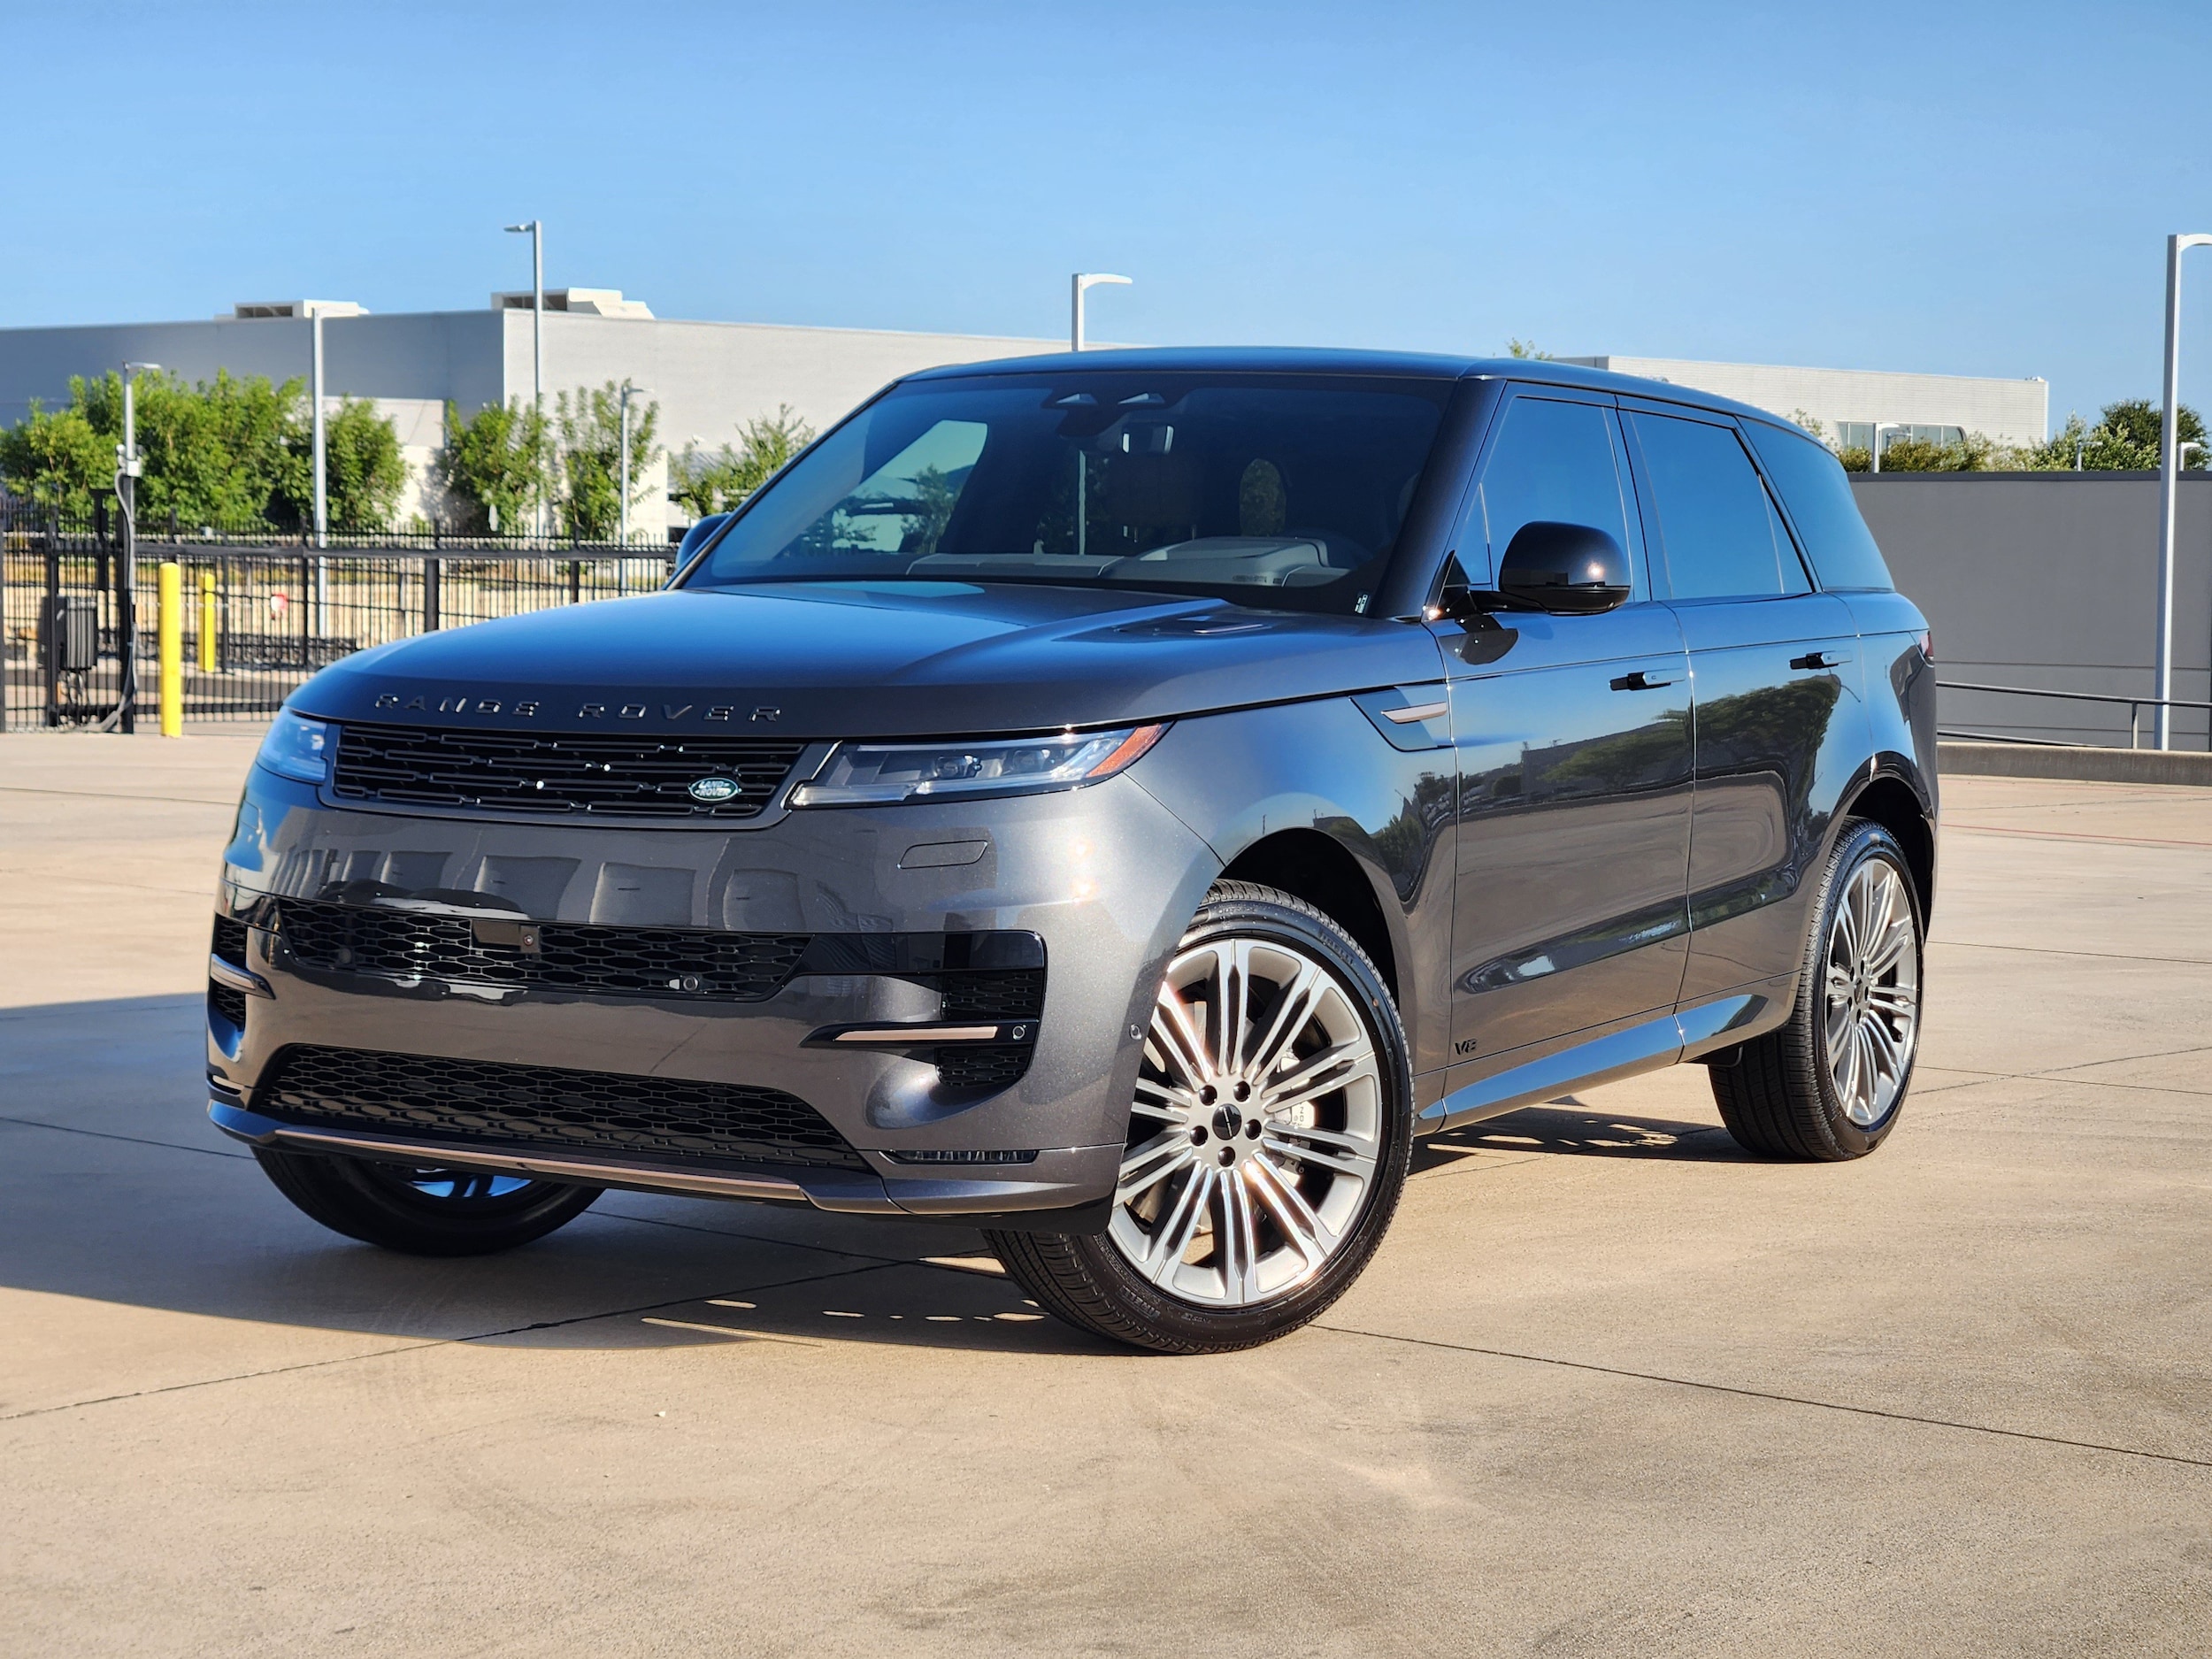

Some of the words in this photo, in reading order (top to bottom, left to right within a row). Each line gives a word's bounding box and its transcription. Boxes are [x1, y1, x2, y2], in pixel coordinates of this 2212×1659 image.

[375, 693, 540, 717] RANGE
[577, 703, 780, 722] ROVER
[700, 787, 732, 796] ROVER
